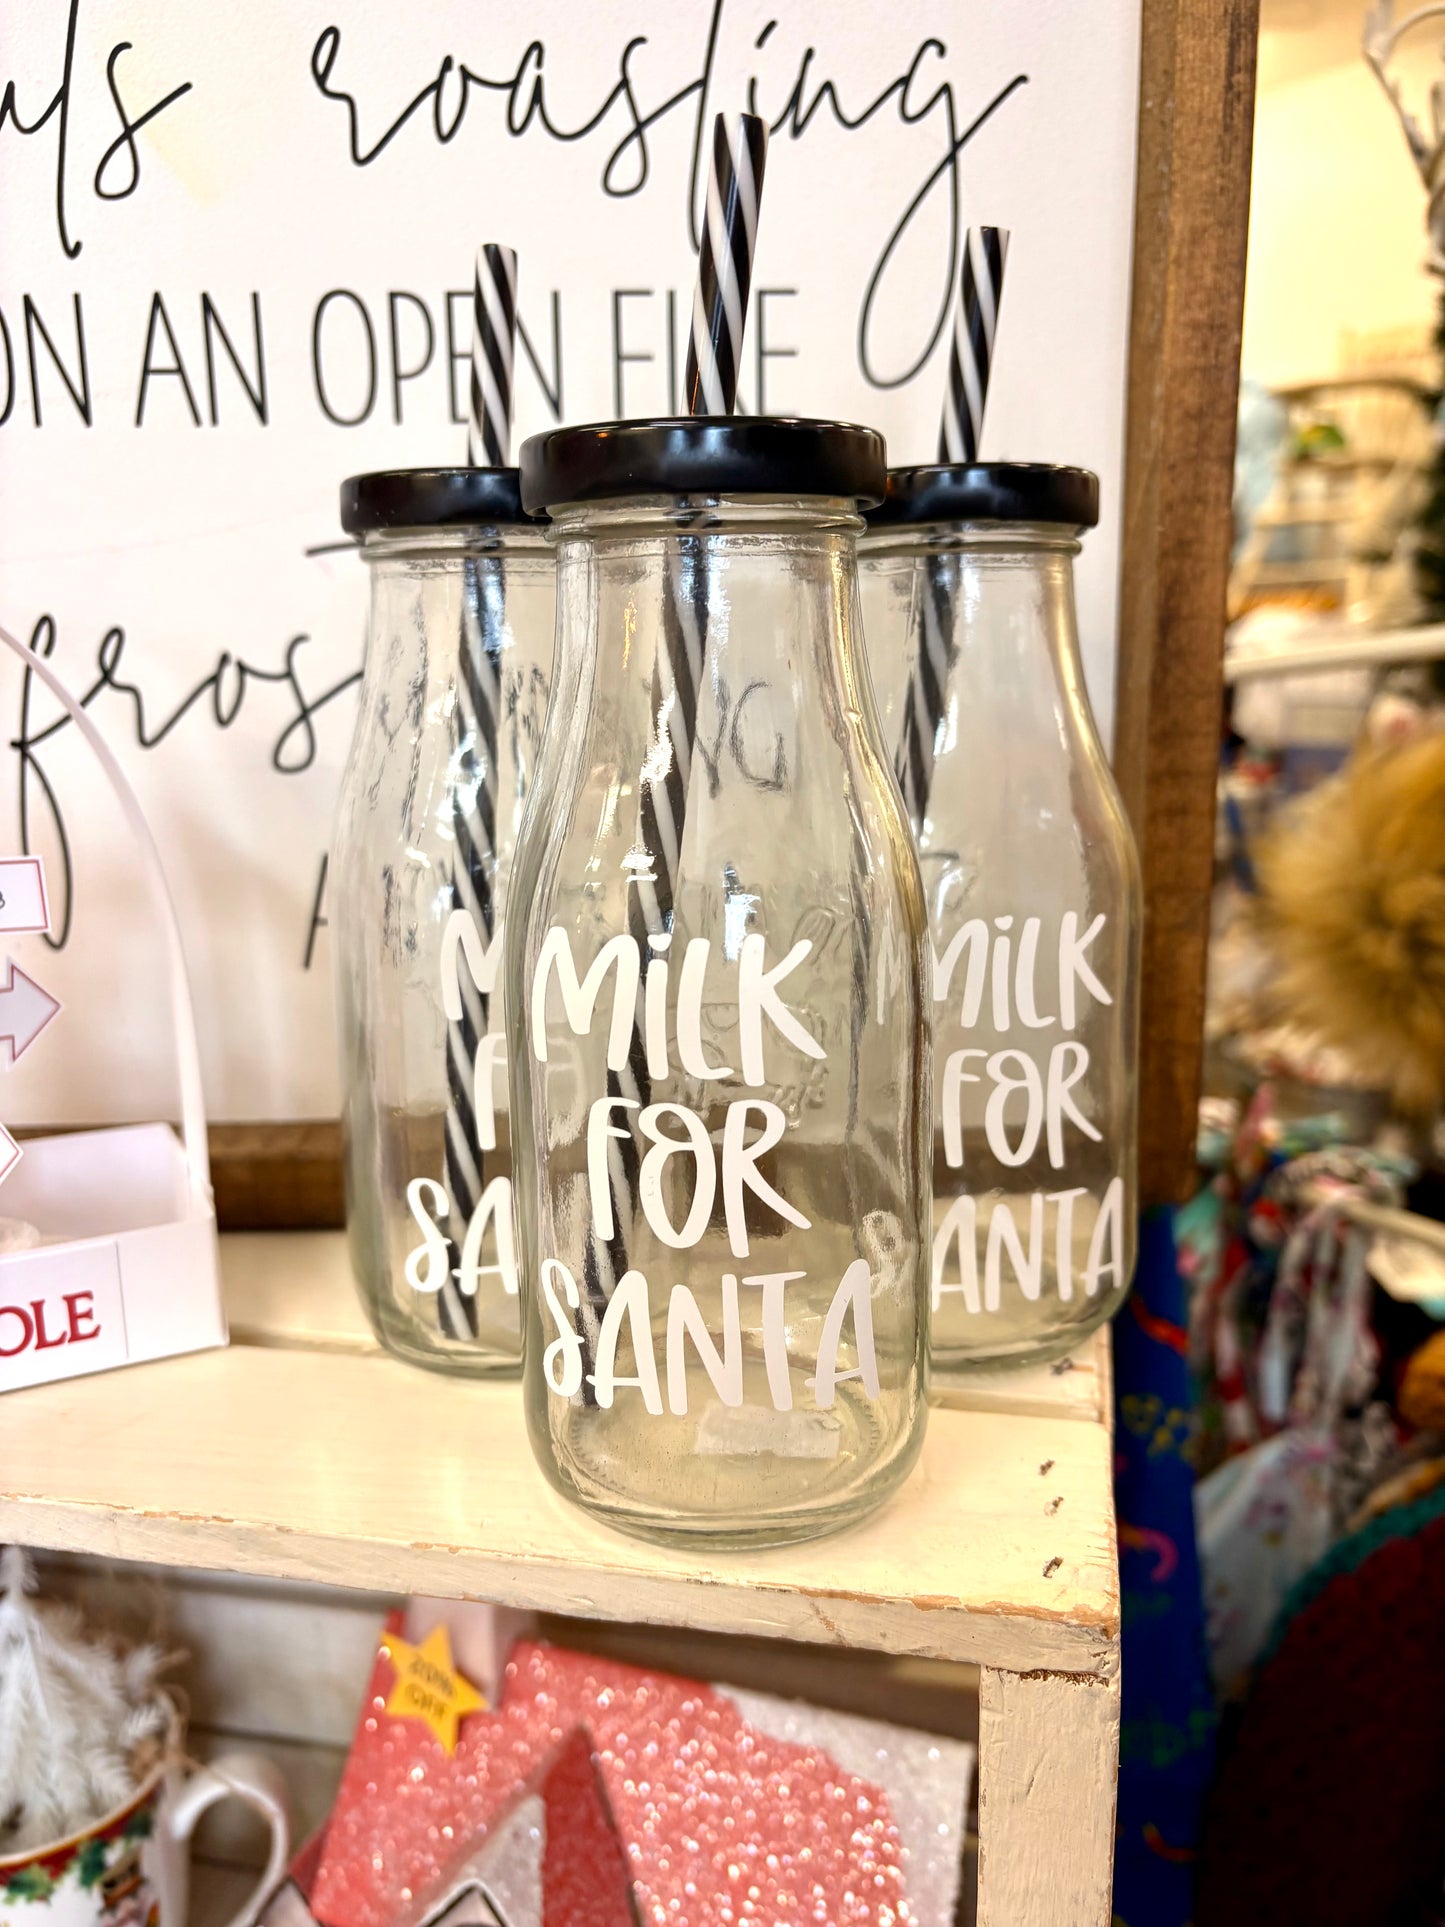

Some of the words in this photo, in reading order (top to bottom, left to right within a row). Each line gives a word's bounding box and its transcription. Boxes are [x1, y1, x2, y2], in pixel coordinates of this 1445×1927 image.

[311, 0, 1029, 390] roasting
[0, 291, 93, 428] N
[134, 291, 269, 428] AN
[611, 288, 798, 420] FIE
[10, 545, 364, 950] fros
[586, 1097, 812, 1258] FOR
[942, 1041, 1103, 1169] FOR
[932, 1176, 1124, 1314] ANTA
[540, 1258, 880, 1416] SANTA
